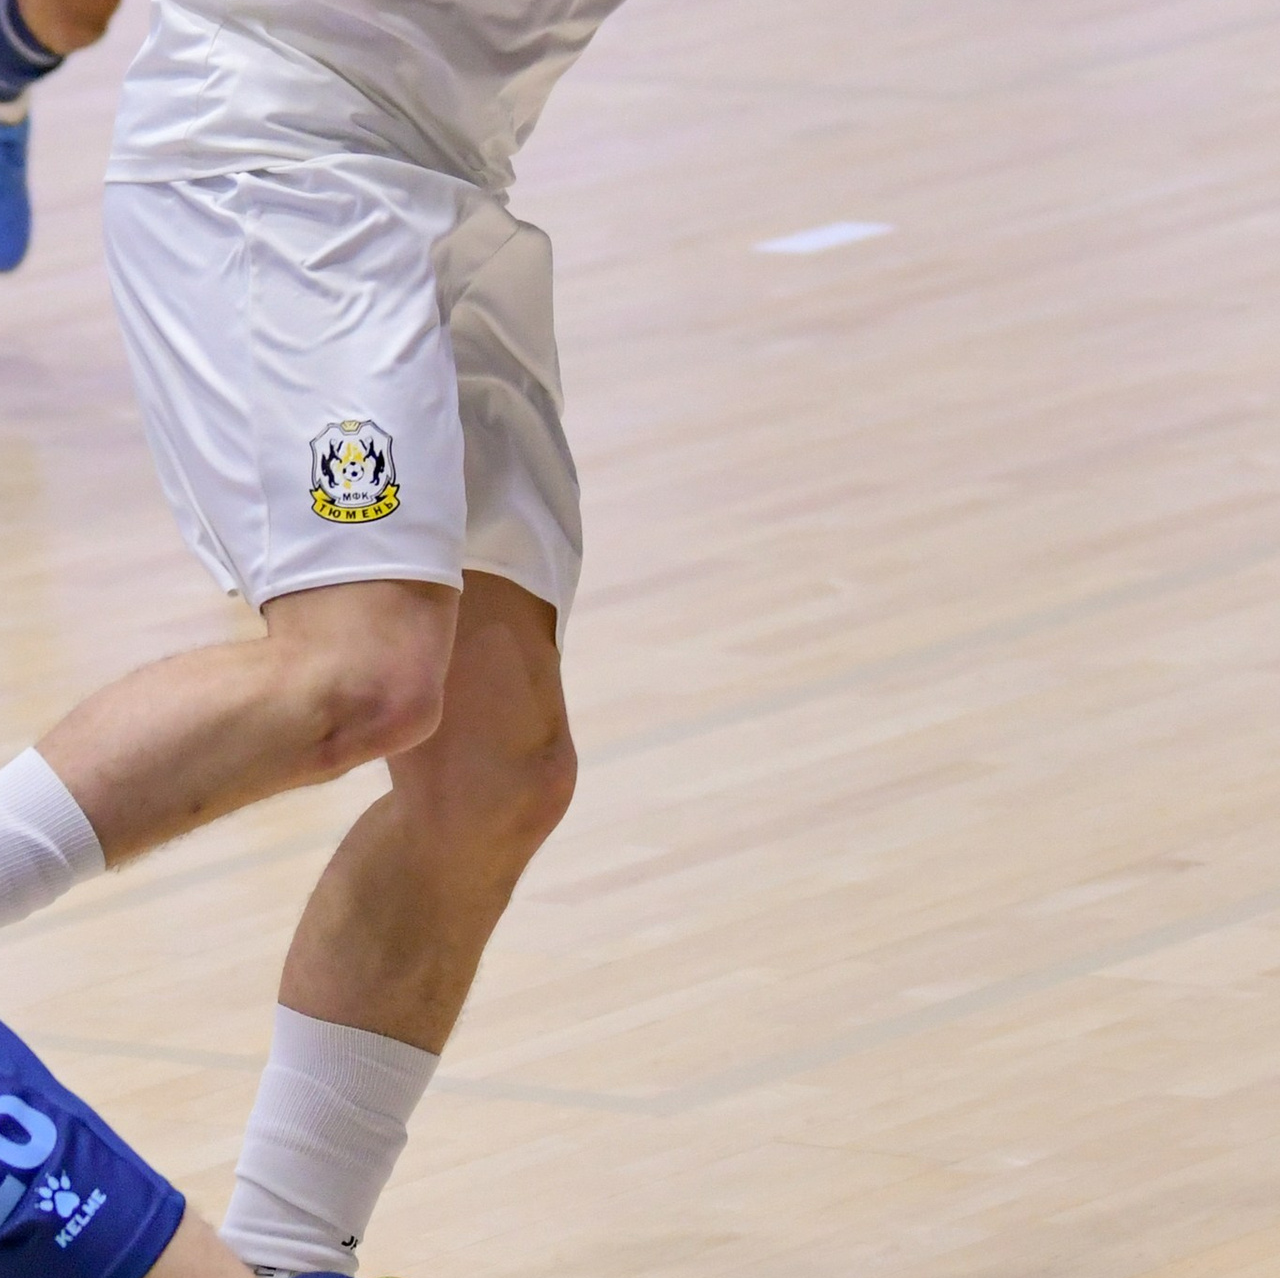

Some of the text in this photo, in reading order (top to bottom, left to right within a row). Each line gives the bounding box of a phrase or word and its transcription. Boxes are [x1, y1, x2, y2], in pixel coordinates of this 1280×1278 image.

[342, 492, 370, 502] МФК
[319, 501, 394, 520] ТЮМЕНЬ
[54, 1187, 108, 1249] KELME
